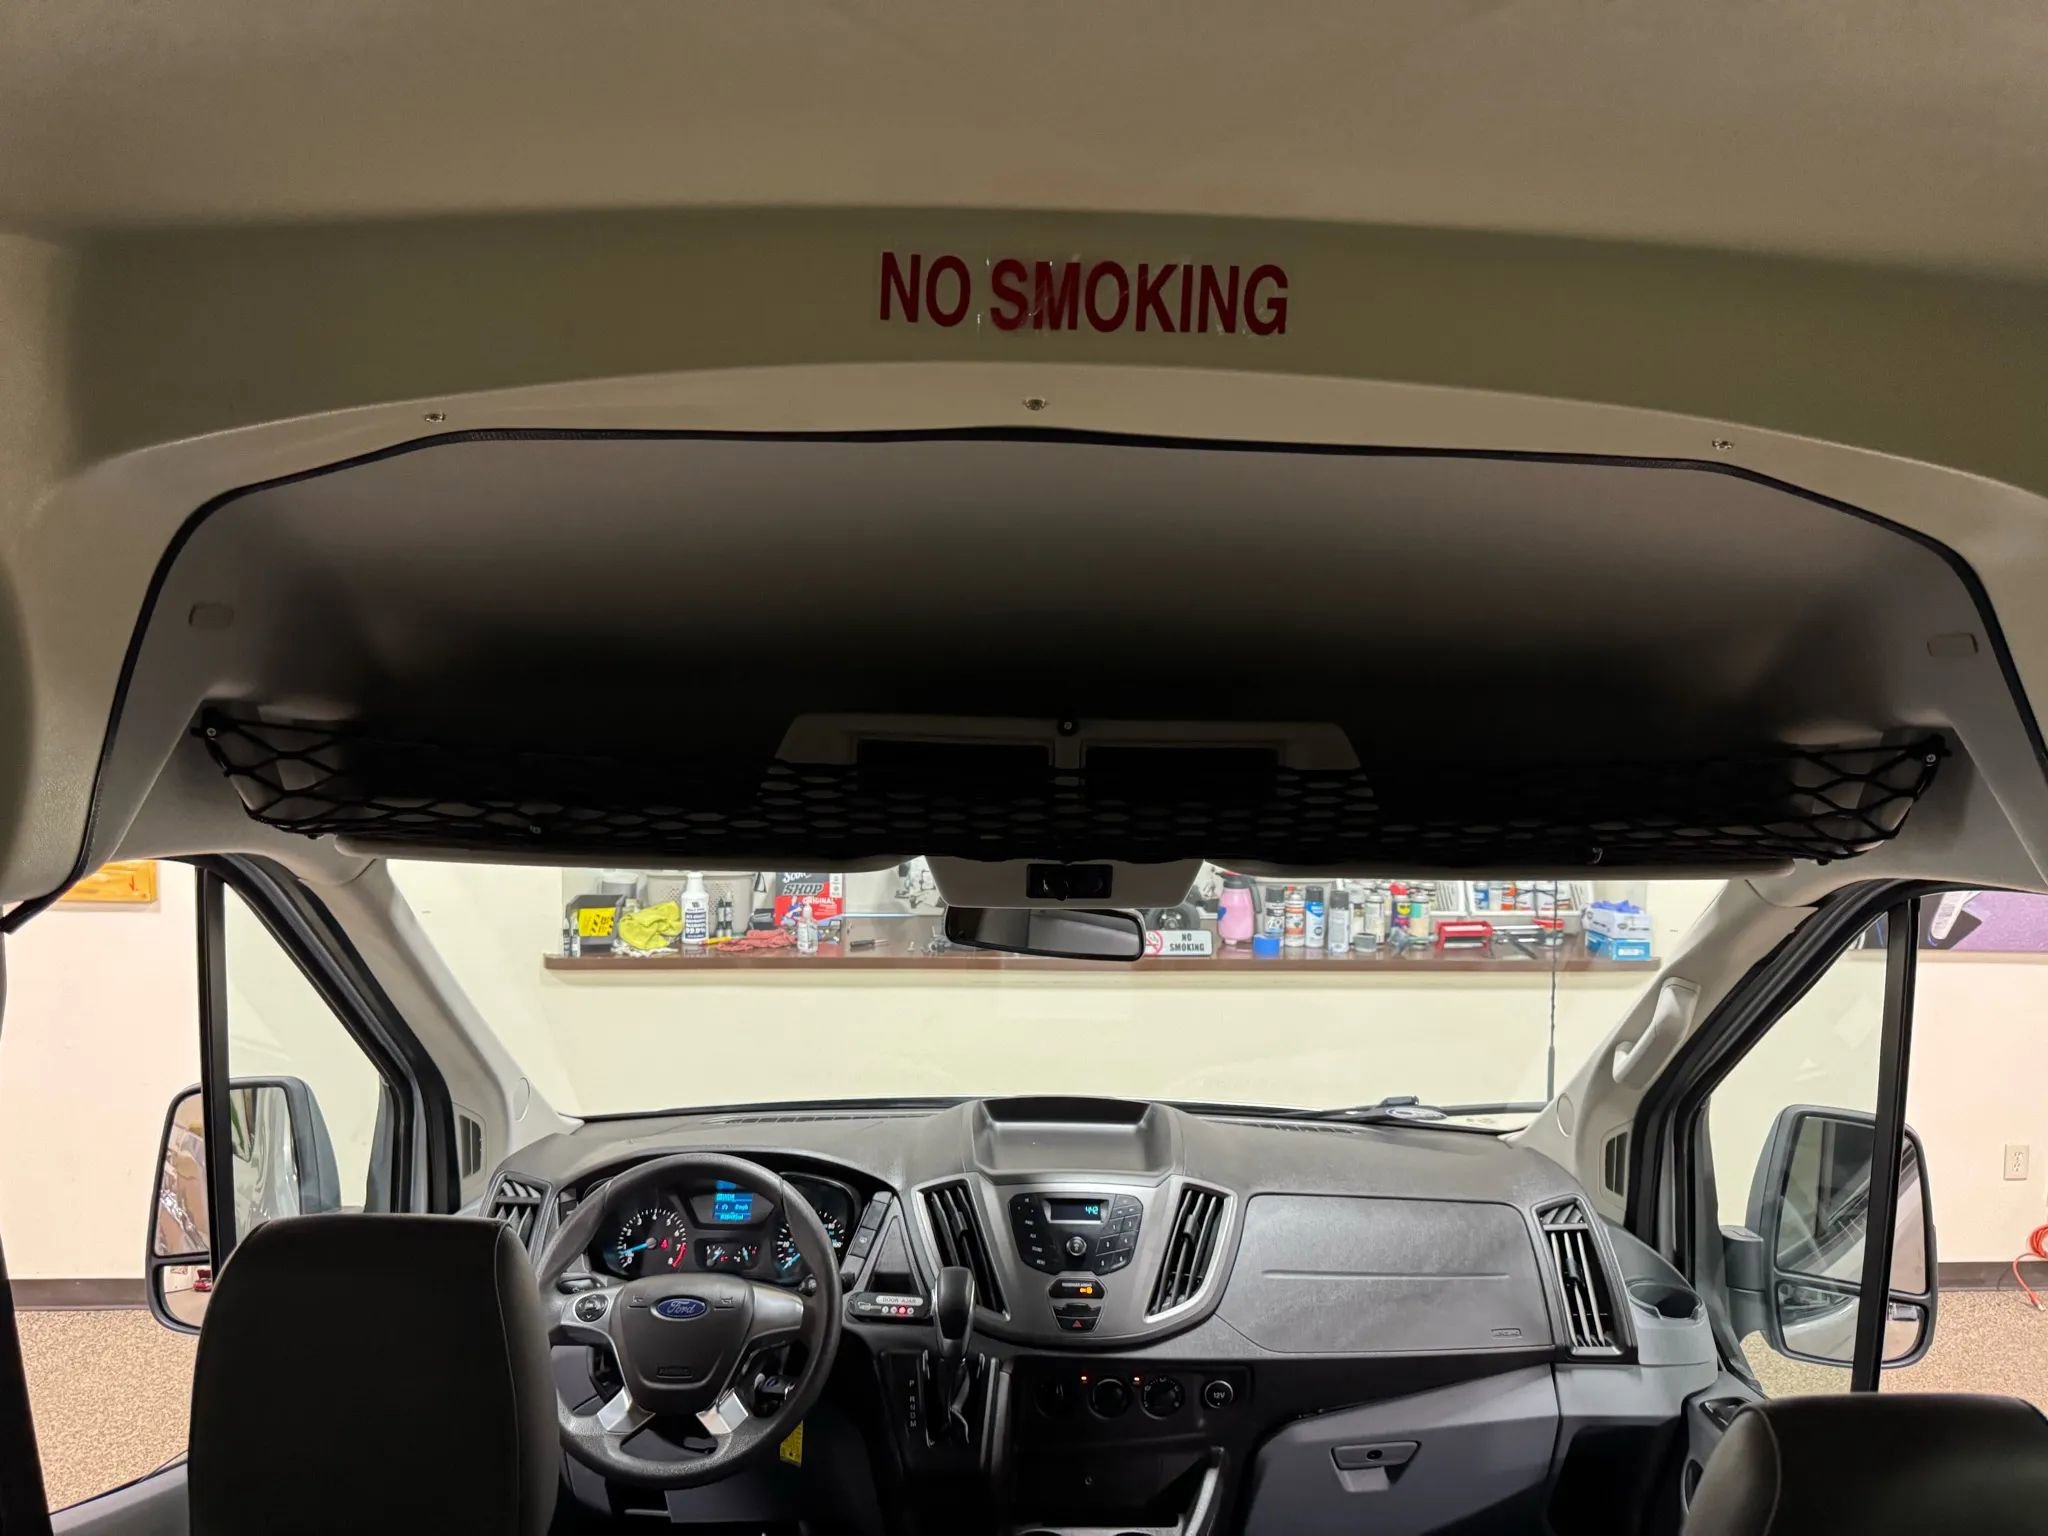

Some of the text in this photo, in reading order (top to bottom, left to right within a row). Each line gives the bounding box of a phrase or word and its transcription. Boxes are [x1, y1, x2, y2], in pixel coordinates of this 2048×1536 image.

[880, 251, 1289, 335] NO SMOKING
[783, 883, 824, 896] SHOP
[1181, 933, 1192, 941] NO
[1169, 943, 1205, 952] SMOKING
[667, 1301, 696, 1314] Ford
[1213, 1391, 1226, 1399] 12V
